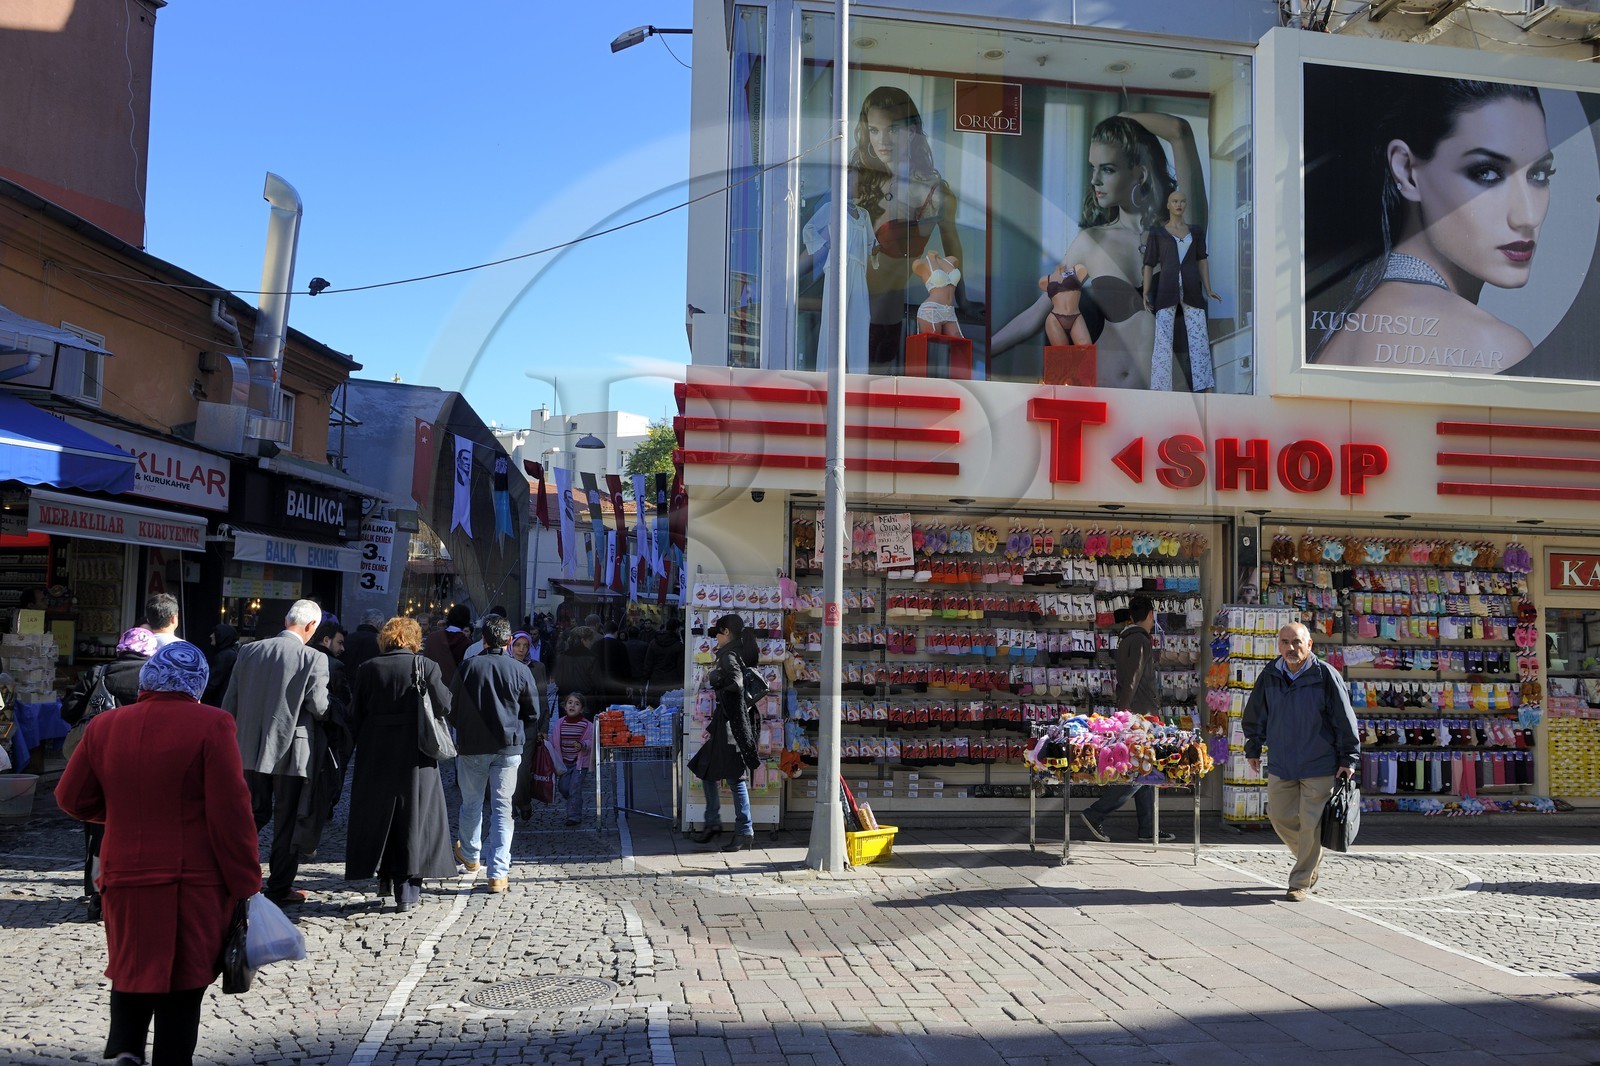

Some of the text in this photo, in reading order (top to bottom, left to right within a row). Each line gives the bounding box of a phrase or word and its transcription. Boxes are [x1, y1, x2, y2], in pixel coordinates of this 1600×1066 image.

[1309, 310, 1440, 337] KUSURSUZ
[1374, 343, 1503, 369] DUDAKLAR
[115, 444, 226, 498] KLILAR
[1155, 433, 1390, 496] SHOP
[143, 474, 191, 491] KURUKAHVE
[39, 505, 124, 535] MERAKLILAR
[362, 523, 394, 536] BALIKÇA
[375, 535, 392, 545] EKMEK
[265, 540, 340, 569] BALIK EKMEK
[363, 543, 379, 561] 3
[881, 545, 892, 564] 5
[360, 572, 377, 590] 3
